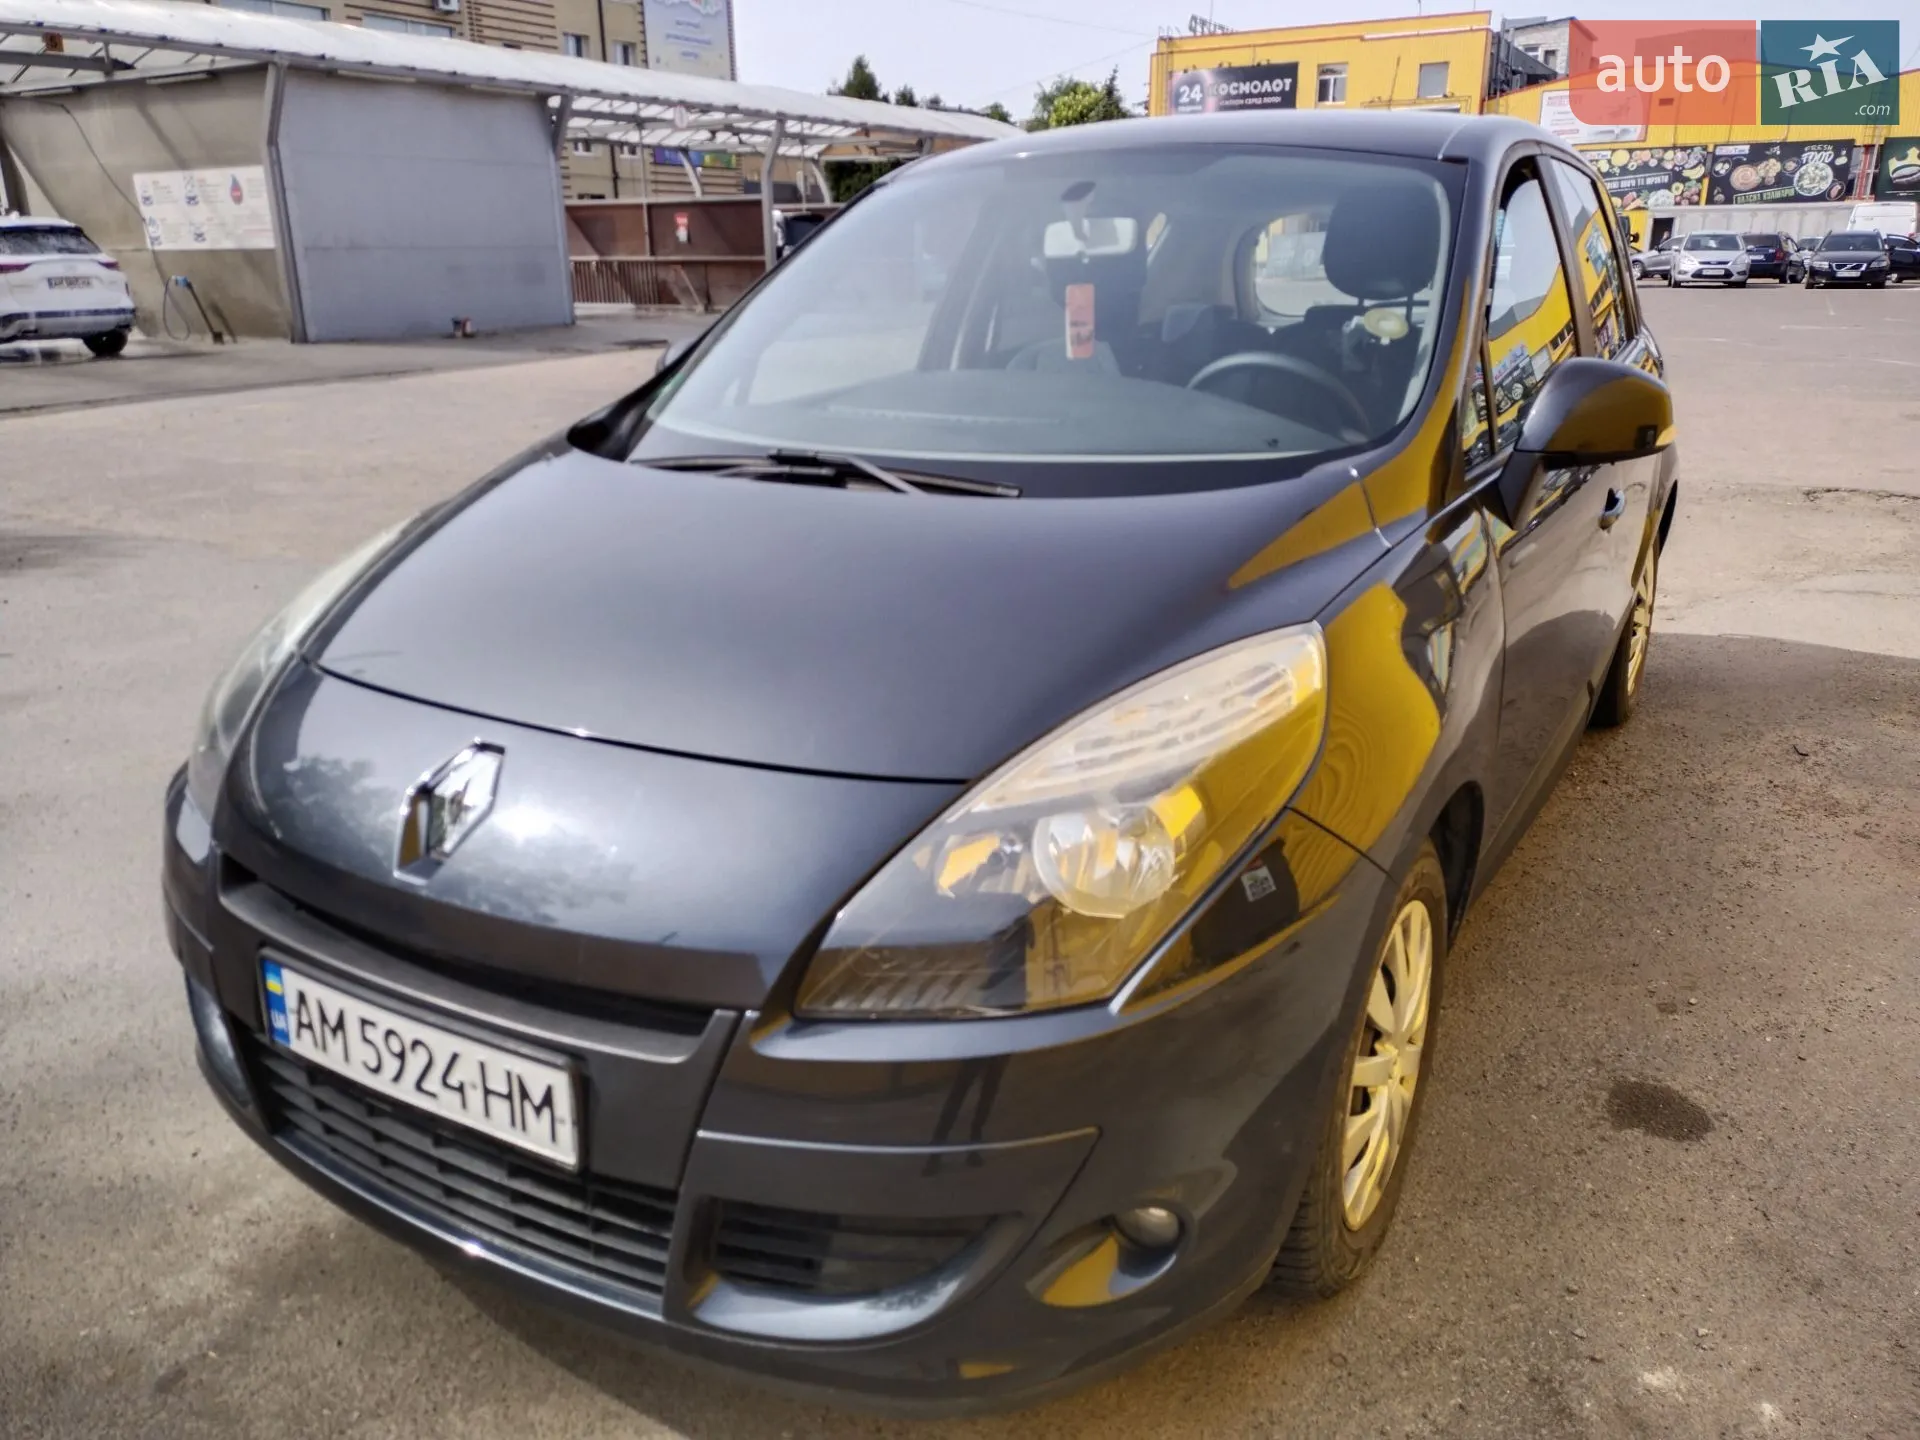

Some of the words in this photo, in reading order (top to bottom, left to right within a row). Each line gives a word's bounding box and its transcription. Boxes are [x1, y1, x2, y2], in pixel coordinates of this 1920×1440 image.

[1179, 84, 1203, 103] 24
[1208, 78, 1292, 96] КОСМОЛОТ
[1801, 151, 1834, 164] FOOD
[296, 990, 349, 1065] AM
[359, 1017, 468, 1110] 5924
[480, 1060, 556, 1143] HM
